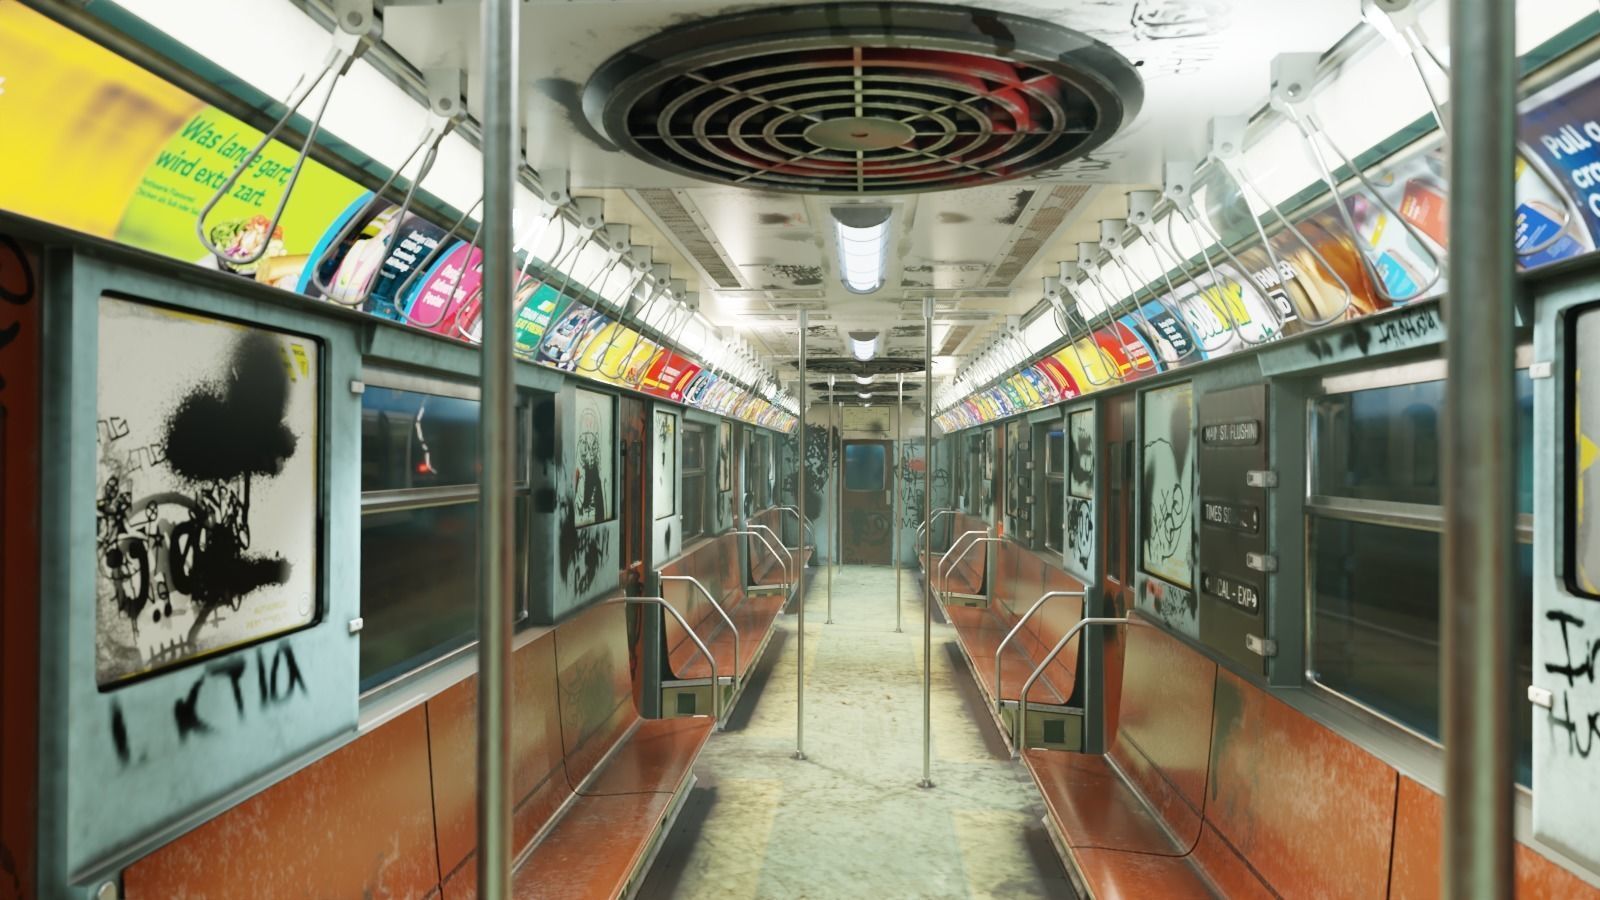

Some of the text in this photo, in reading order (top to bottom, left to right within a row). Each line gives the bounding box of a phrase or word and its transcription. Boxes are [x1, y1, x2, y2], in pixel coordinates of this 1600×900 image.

[181, 114, 222, 150] Was
[1541, 123, 1592, 160] Pull
[155, 150, 201, 178] wird
